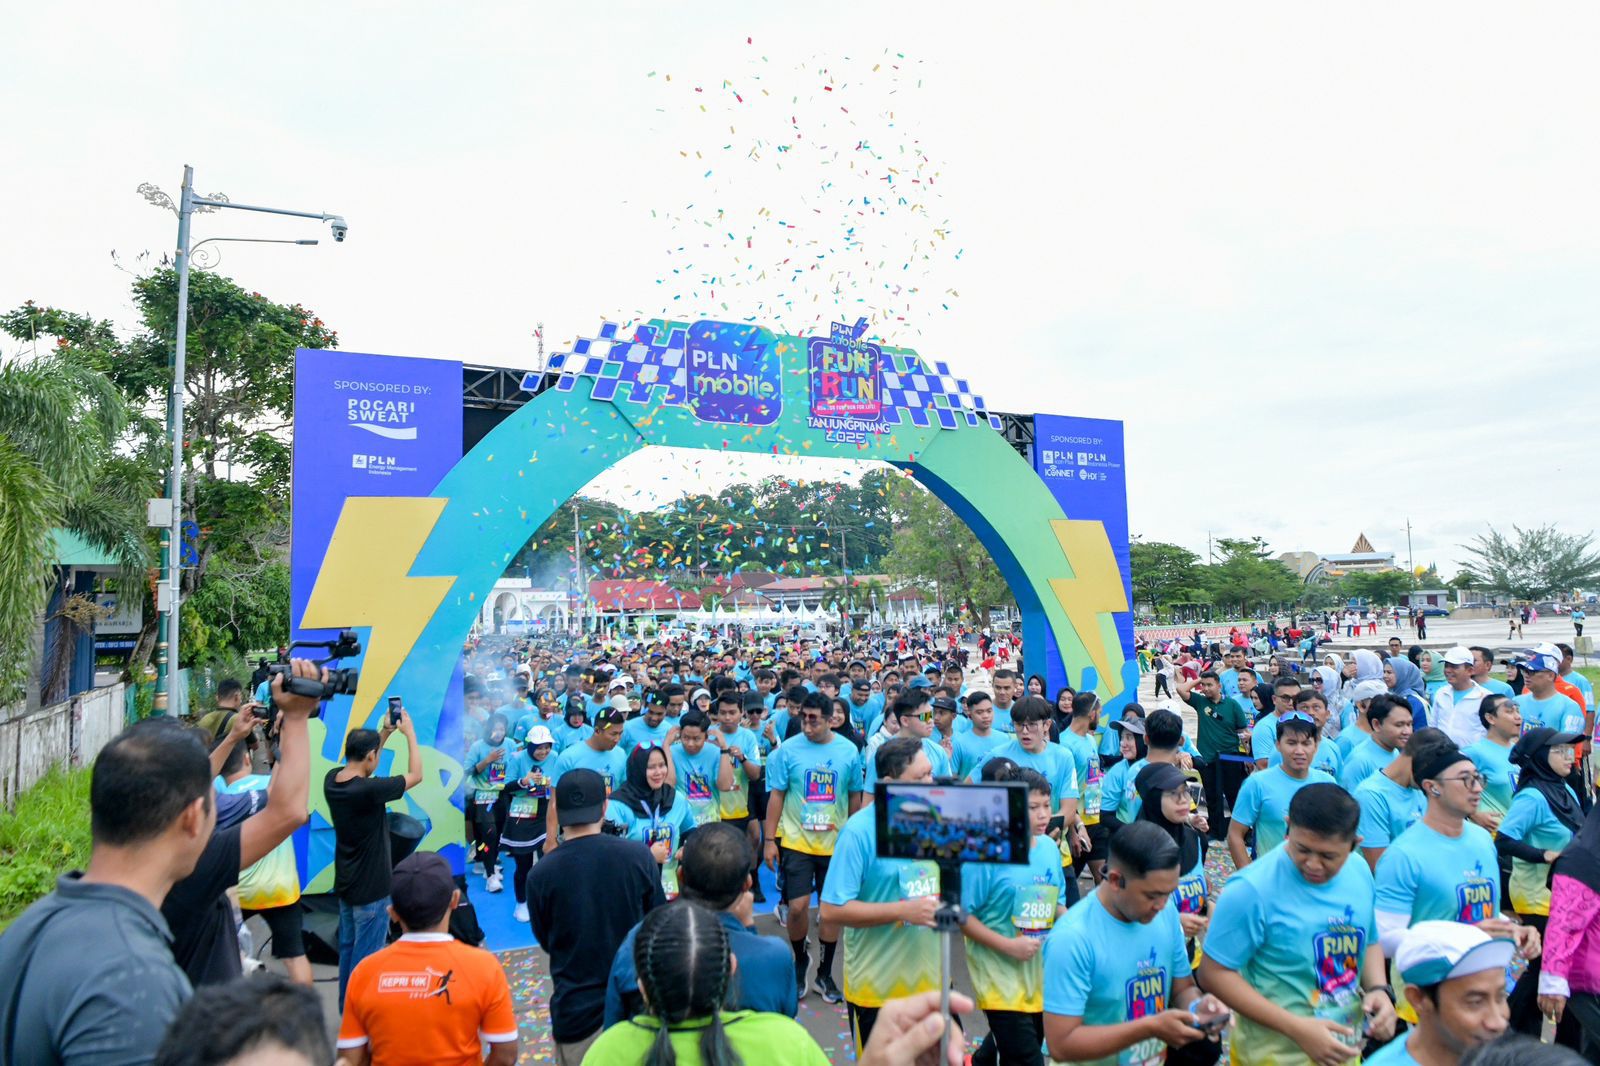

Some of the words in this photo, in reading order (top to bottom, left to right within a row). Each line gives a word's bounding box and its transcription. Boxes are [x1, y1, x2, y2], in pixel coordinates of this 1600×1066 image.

[693, 350, 738, 371] PLN
[823, 345, 870, 374] FUN
[334, 381, 410, 393] SPONSORED
[414, 385, 432, 395] BY:
[693, 373, 774, 398] mobile
[822, 372, 874, 401] RUN
[348, 399, 415, 413] POCARI
[348, 410, 409, 423] SWEAT
[807, 417, 891, 433] TANJUNGPINANG
[826, 431, 866, 443] 2025
[1051, 435, 1092, 445] SPONSORED
[369, 455, 395, 465] PLN
[1054, 451, 1074, 460] PLN
[1088, 453, 1107, 462] PLN
[810, 772, 833, 784] FUN
[810, 782, 833, 795] RUN
[805, 813, 831, 824] 2182
[907, 877, 937, 897] 2347
[1178, 881, 1203, 900] FUN
[1464, 885, 1490, 905] FUN
[1021, 902, 1051, 918] 2888
[1323, 935, 1358, 958] FUN
[381, 976, 408, 987] KEPRI
[1133, 976, 1162, 1001] FUN
